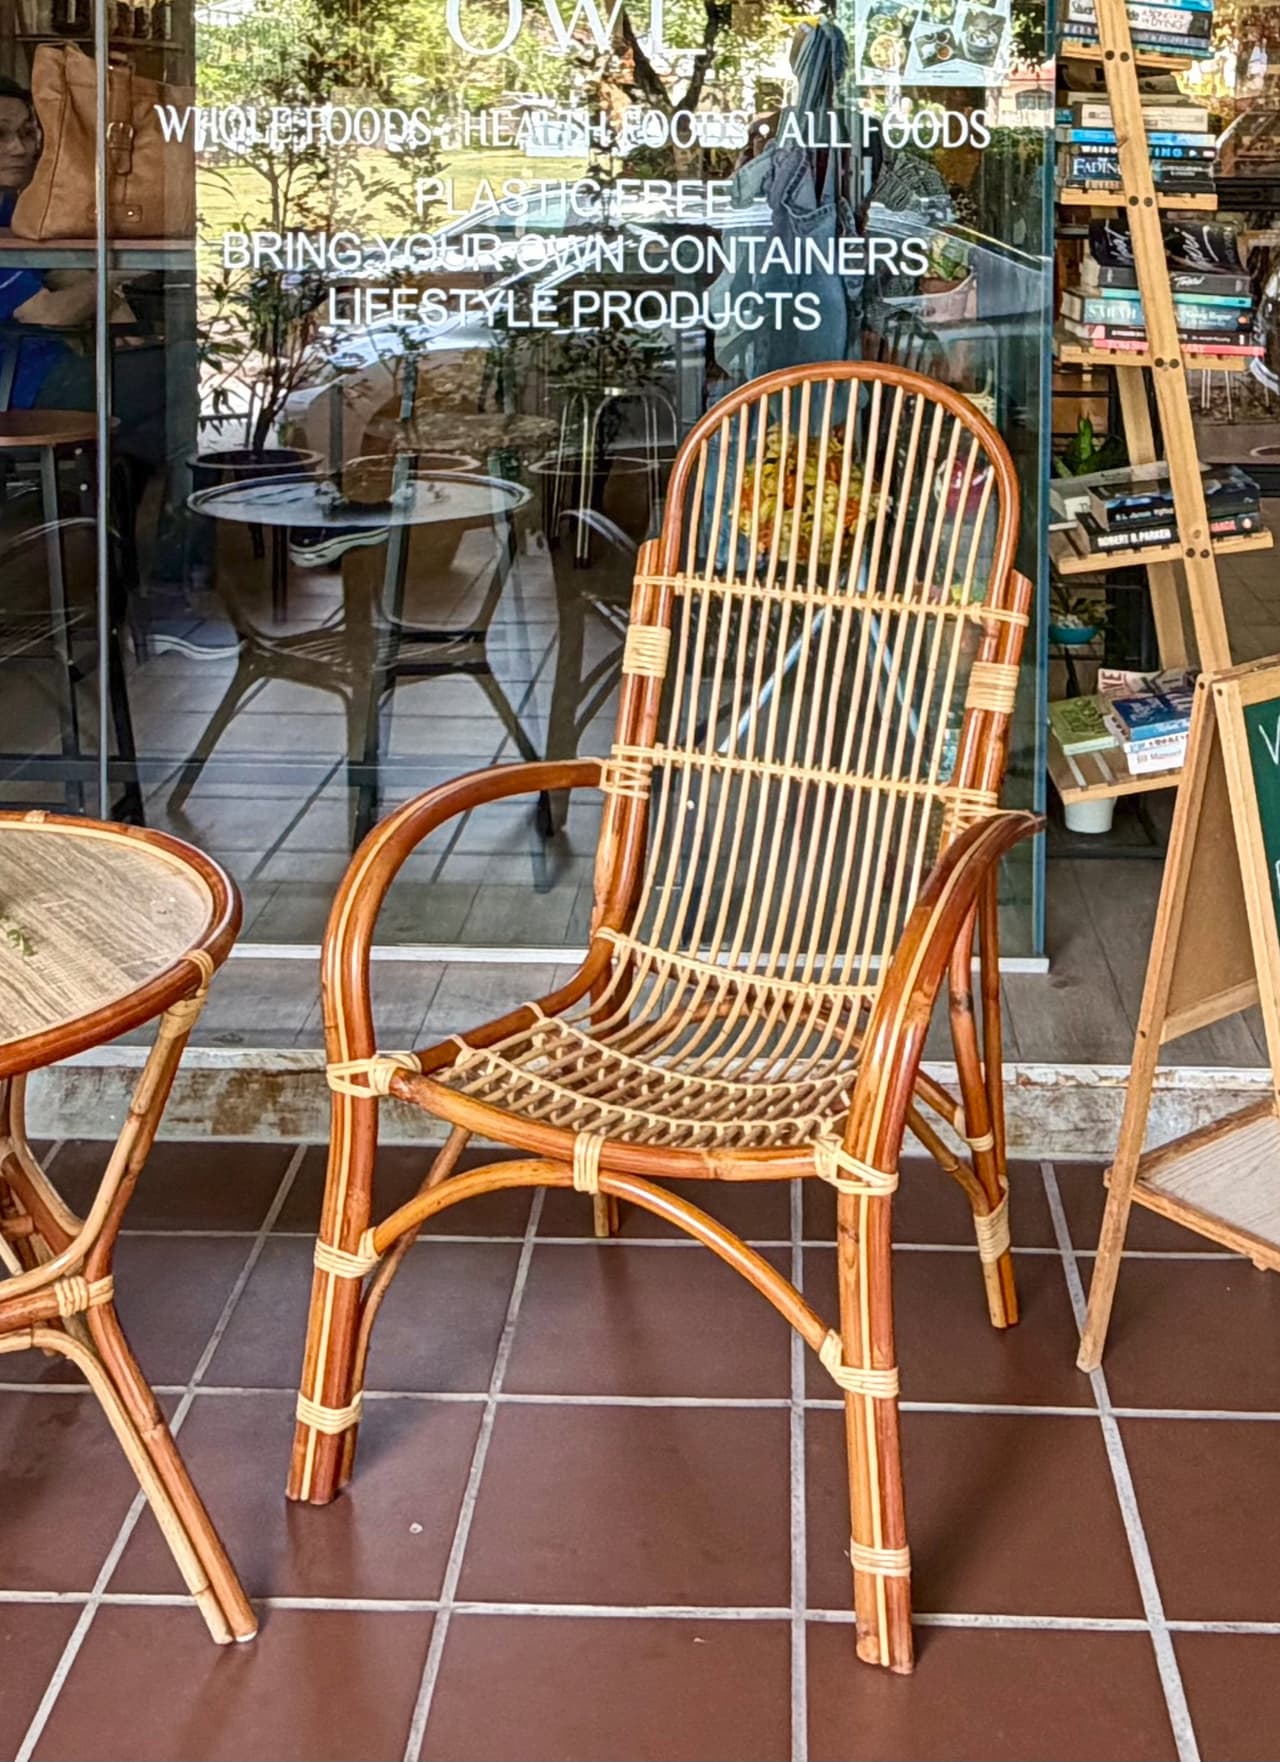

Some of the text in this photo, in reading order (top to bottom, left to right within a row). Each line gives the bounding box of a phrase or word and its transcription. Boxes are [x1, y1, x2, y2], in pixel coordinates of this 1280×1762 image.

[445, 0, 706, 55] OWL
[154, 104, 992, 150] WHOLE FOODS HEALTH FOODS ALL FOODS
[1080, 145, 1118, 155] WATSO
[415, 177, 734, 219] PLASTIC FREE
[223, 231, 929, 277] BRING YOUR OWN CONTAINERS
[329, 287, 821, 331] LIFESTYLE PRODUCTS
[1097, 533, 1129, 547] ROBERT
[1139, 528, 1172, 542] PARKER
